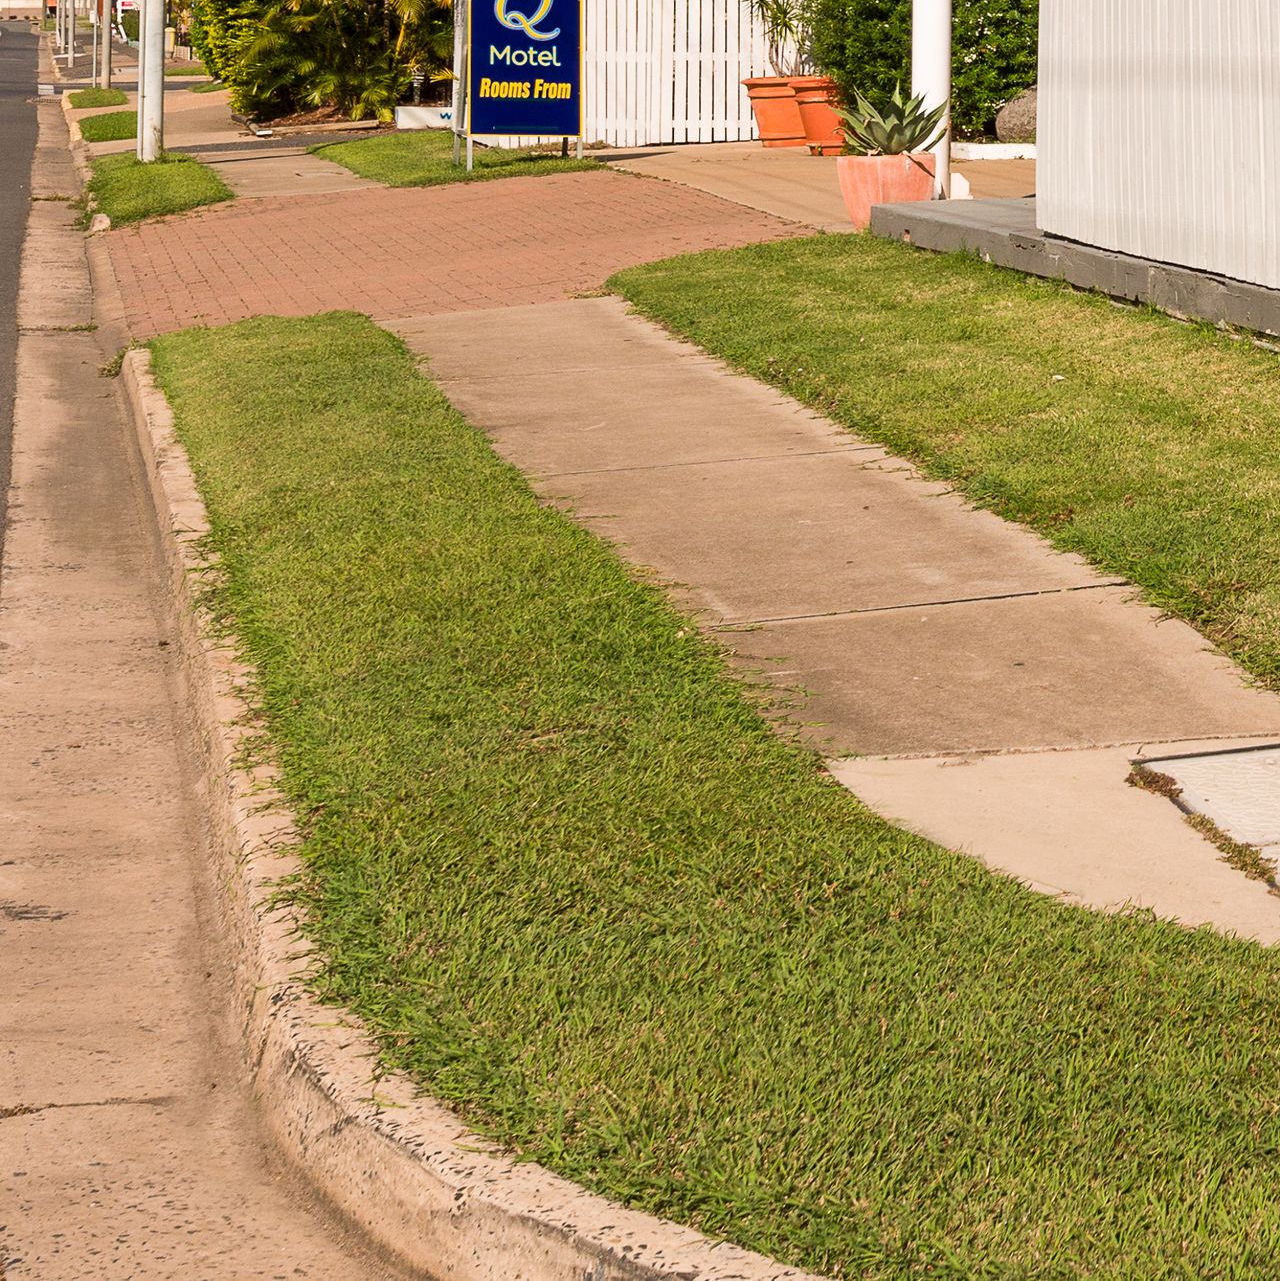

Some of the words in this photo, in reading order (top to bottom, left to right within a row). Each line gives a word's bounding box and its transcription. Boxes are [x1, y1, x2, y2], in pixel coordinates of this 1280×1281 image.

[490, 45, 561, 67] Motel
[480, 77, 531, 99] Rooms
[533, 78, 572, 100] From
